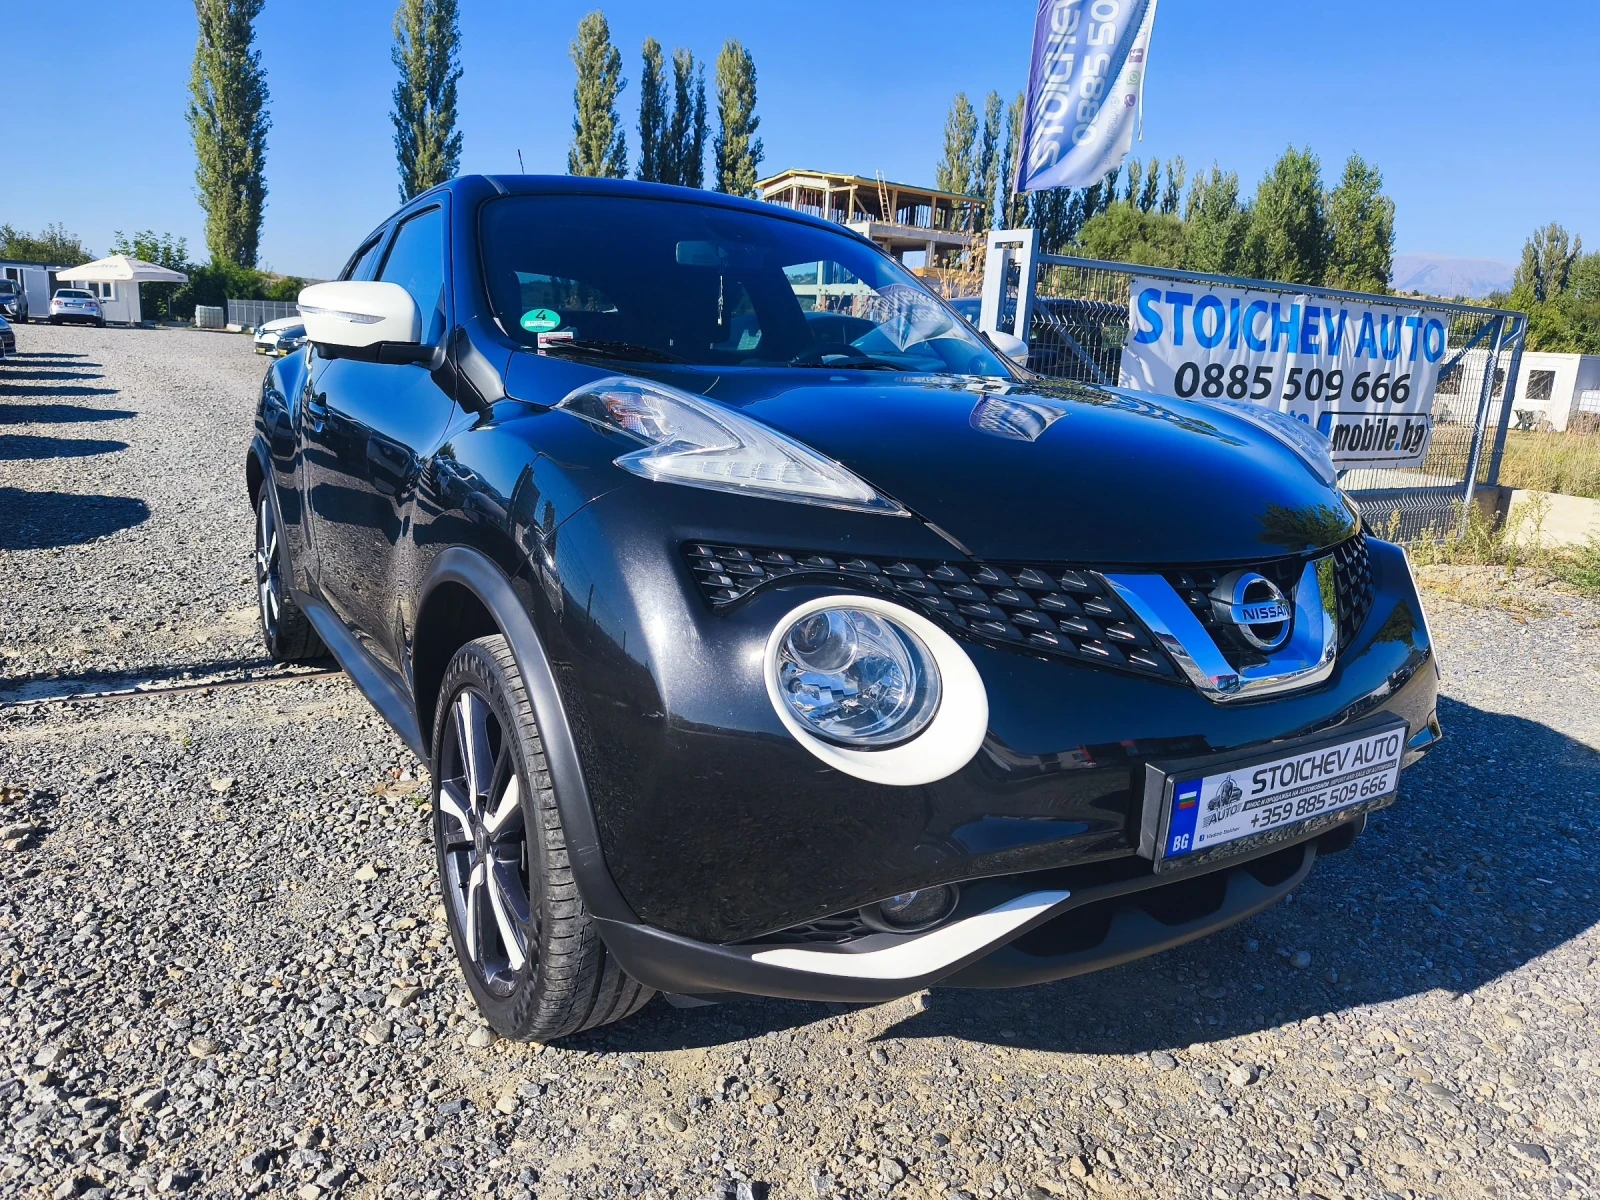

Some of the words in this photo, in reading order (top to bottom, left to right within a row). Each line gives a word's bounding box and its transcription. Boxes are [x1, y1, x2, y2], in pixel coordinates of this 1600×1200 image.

[1072, 53, 1111, 146] 0885
[535, 310, 547, 320] 4
[1133, 288, 1347, 356] STOICHEV
[1354, 311, 1445, 363] AUTO
[1174, 361, 1273, 400] 0885
[1282, 367, 1344, 402] 509
[1351, 371, 1410, 403] 666
[1332, 418, 1425, 454] mobile.bg
[1242, 603, 1291, 620] NISSAN
[1251, 746, 1351, 795] STOICHEV
[1351, 734, 1399, 768] AUTO
[1209, 804, 1238, 825] AUTO
[1251, 802, 1293, 828] +359
[1296, 792, 1327, 816] 885
[1328, 783, 1358, 807] 509
[1360, 774, 1388, 797] 666
[1172, 833, 1190, 852] BG
